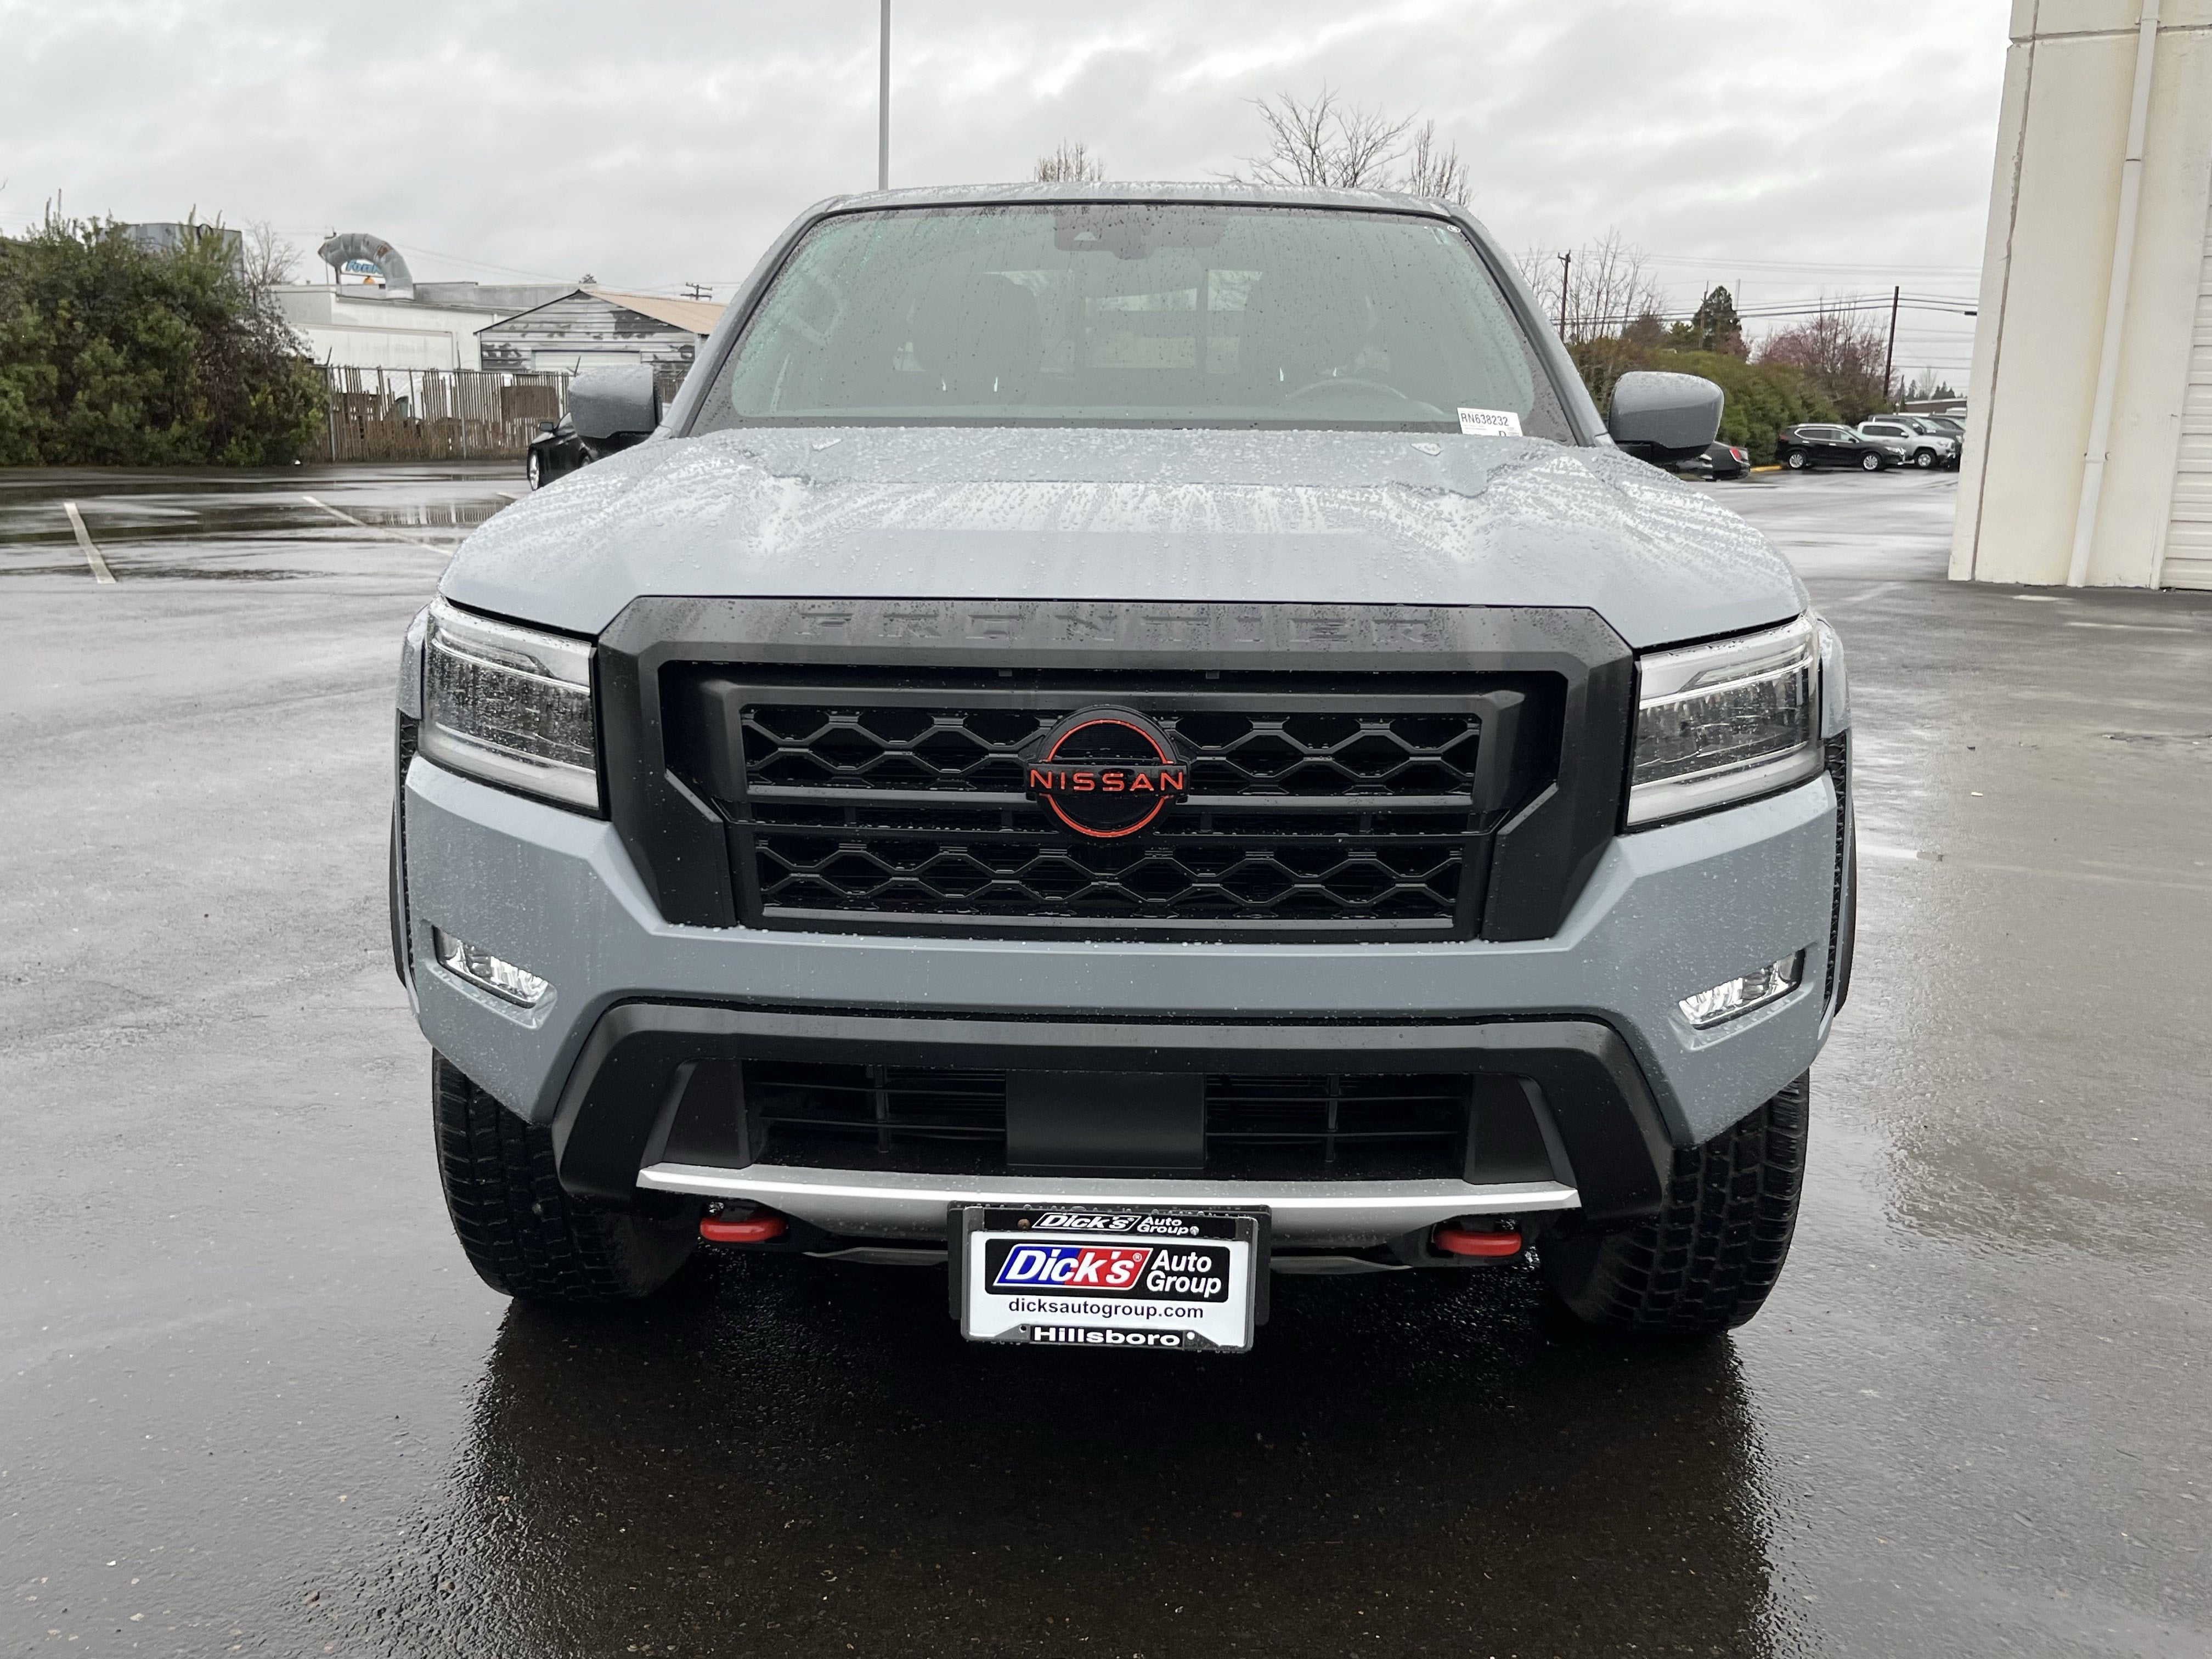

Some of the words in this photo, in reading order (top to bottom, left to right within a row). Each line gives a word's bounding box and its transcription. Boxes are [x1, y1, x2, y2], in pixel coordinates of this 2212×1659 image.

[1460, 413, 1509, 426] RN638232
[1029, 769, 1183, 791] NISSAN
[1137, 1224, 1189, 1235] Group
[1141, 1216, 1182, 1227] Auto
[1151, 1250, 1211, 1273] Auto
[1146, 1271, 1221, 1298] Group
[1008, 1297, 1204, 1319] dicksautogroup.com
[1034, 1326, 1181, 1347] Hillsboro
